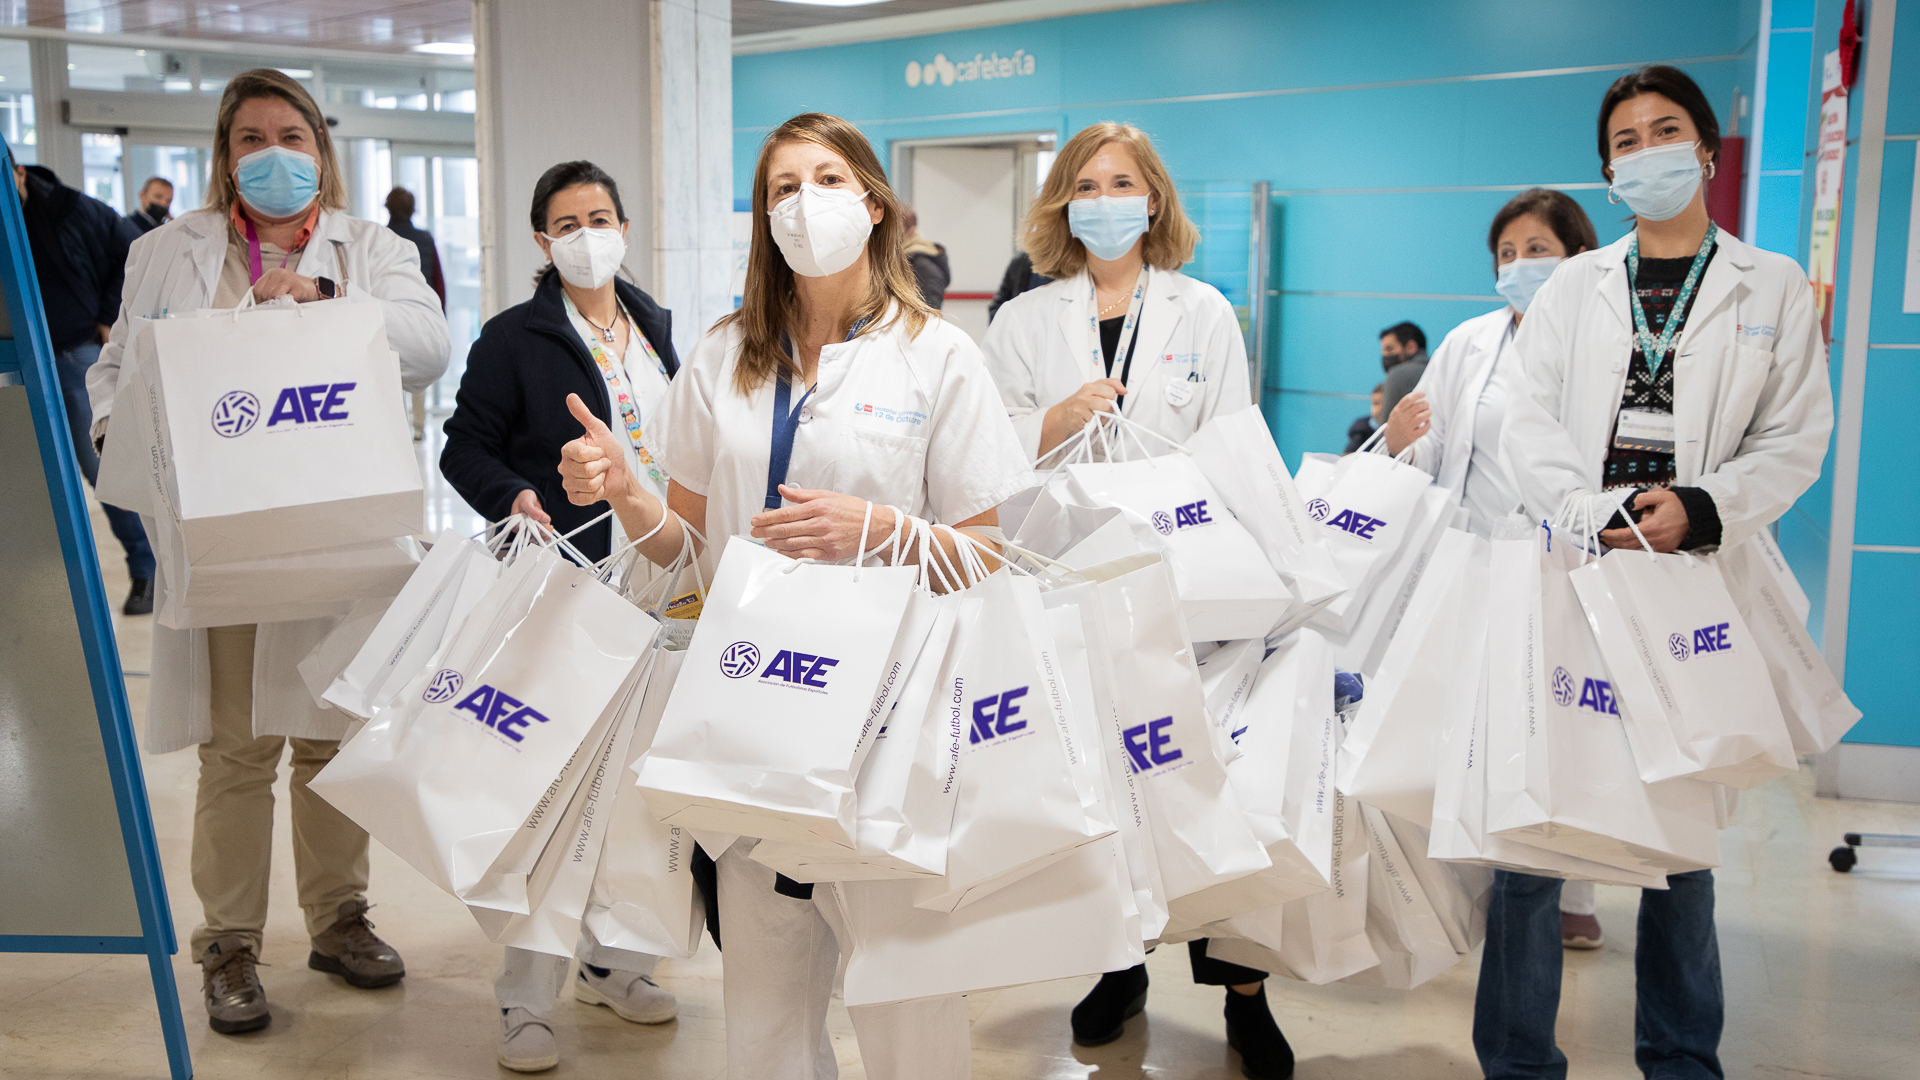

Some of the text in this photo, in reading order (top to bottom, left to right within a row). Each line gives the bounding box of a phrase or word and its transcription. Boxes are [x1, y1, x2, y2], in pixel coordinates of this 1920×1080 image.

[956, 49, 1035, 82] cafetería
[267, 382, 357, 427] AFE
[874, 406, 897, 415] Hospital
[885, 413, 894, 421] de
[1175, 499, 1213, 529] AFE
[1326, 509, 1387, 540] AFE
[1694, 622, 1732, 655] AFE
[760, 649, 840, 689] AFE
[454, 684, 551, 743] AFE
[1041, 651, 1077, 765] www.afe-futbol.com
[943, 677, 964, 794] www.afe-futbol.com
[1123, 716, 1183, 774] FE
